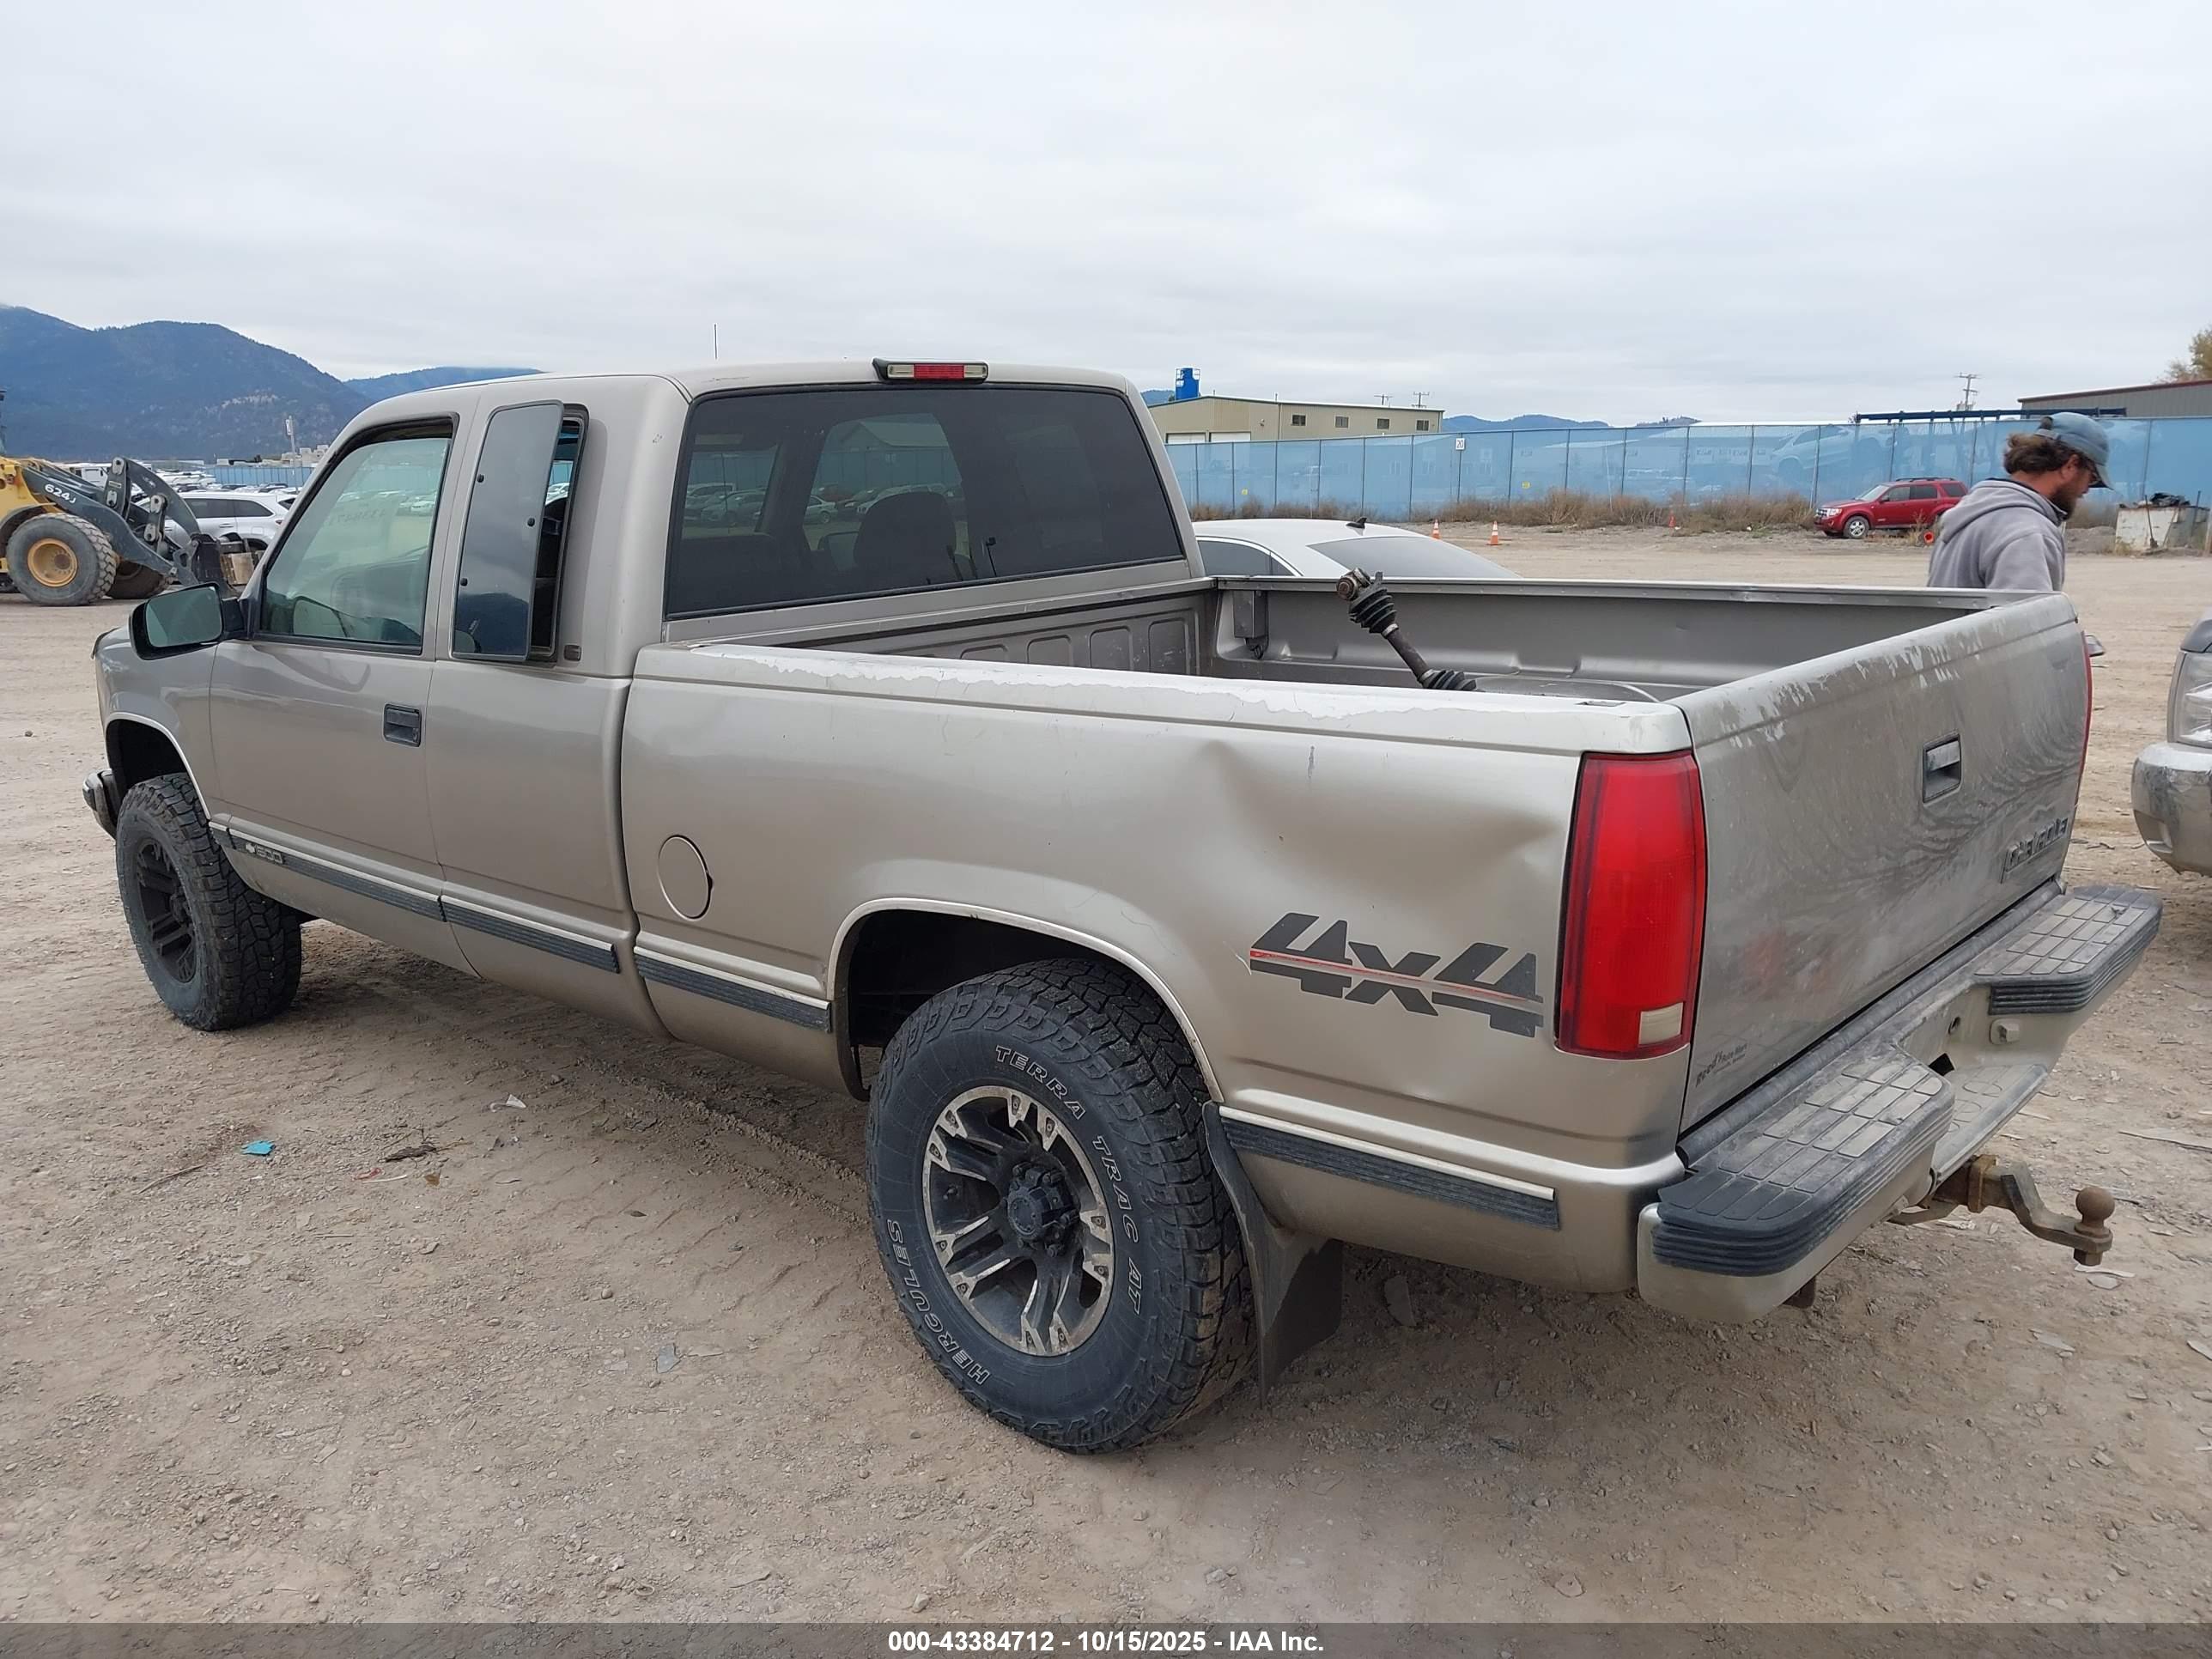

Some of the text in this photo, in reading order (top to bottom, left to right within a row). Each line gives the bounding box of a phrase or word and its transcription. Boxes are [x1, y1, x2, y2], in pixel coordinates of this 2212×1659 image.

[45, 483, 76, 503] 624J
[995, 1044, 1142, 1316] TERRA TRAC AT
[886, 1218, 991, 1386] HERCULES
